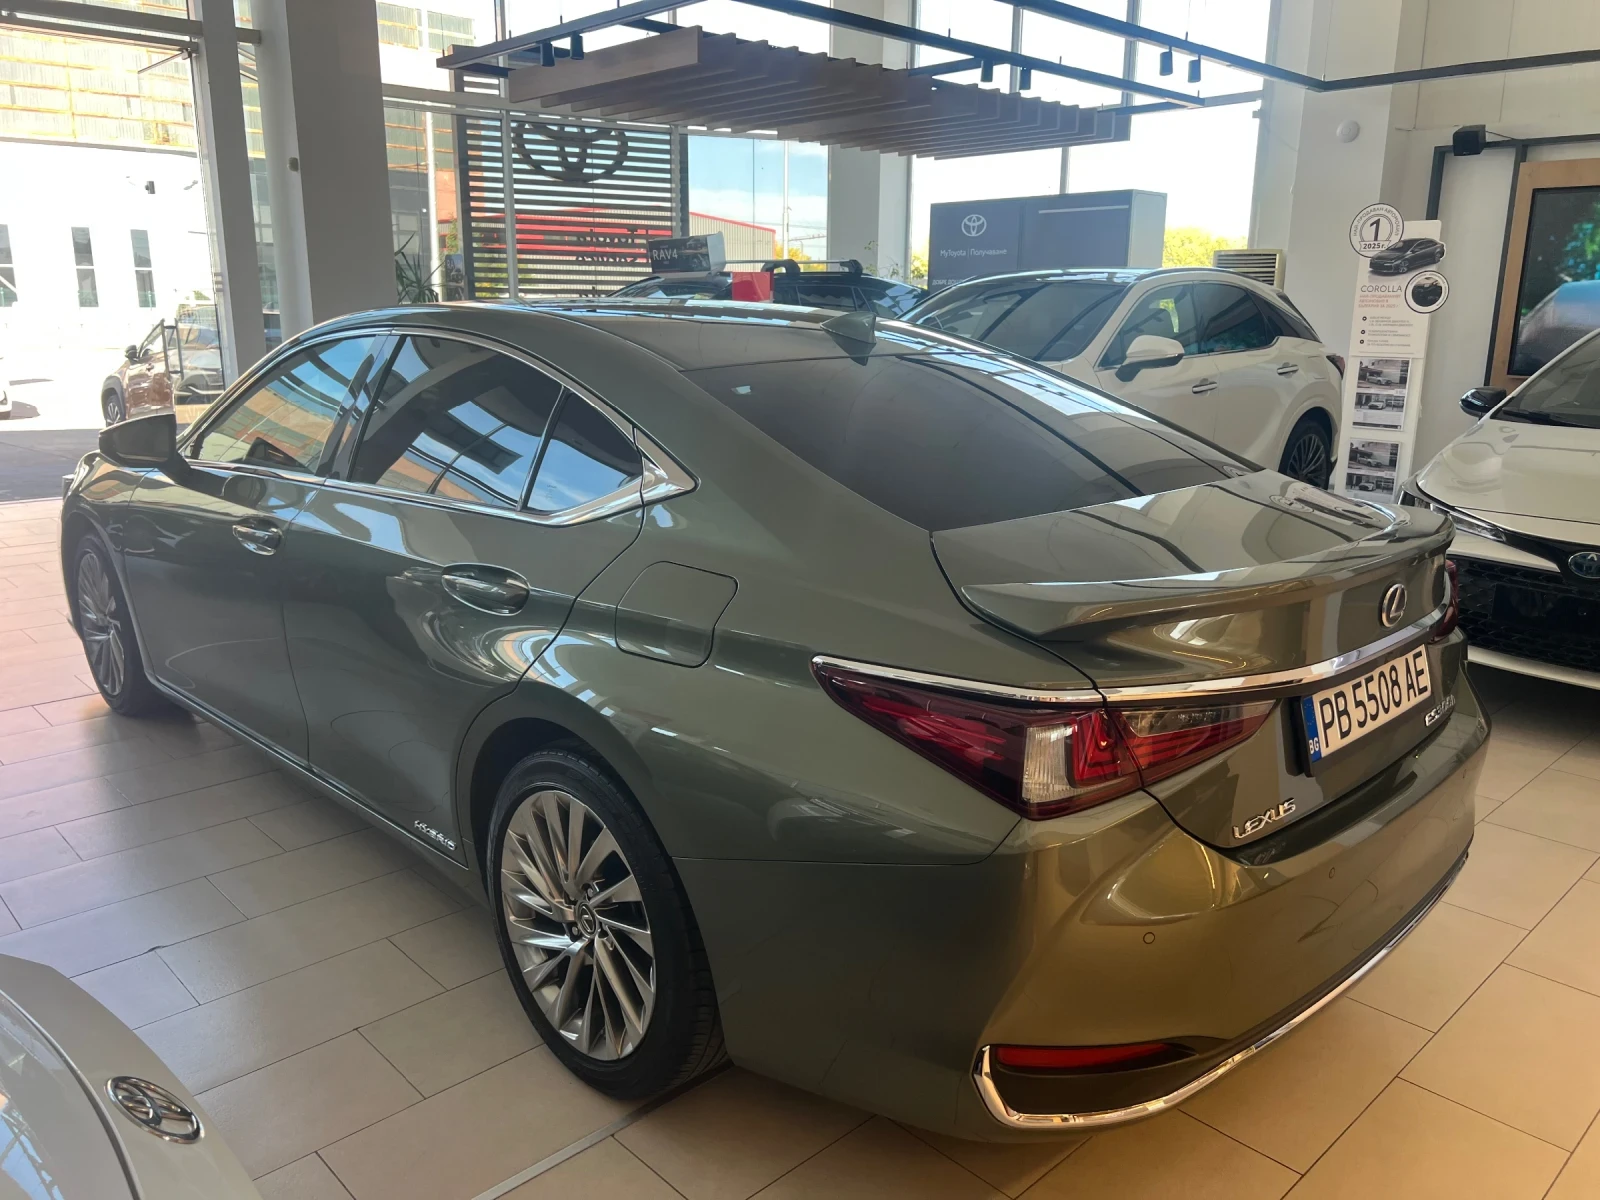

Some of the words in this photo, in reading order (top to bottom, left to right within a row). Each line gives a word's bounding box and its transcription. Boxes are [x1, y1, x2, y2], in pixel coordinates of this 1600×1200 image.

[1369, 218, 1381, 241] 1
[652, 248, 678, 260] RAV4
[940, 249, 967, 258] MyToyota
[1360, 285, 1402, 293] COROLLA
[1318, 690, 1352, 748] PB
[1351, 664, 1402, 728] 5508
[1405, 650, 1428, 702] AE
[1308, 737, 1319, 755] BG
[1233, 798, 1296, 838] LEXUS
